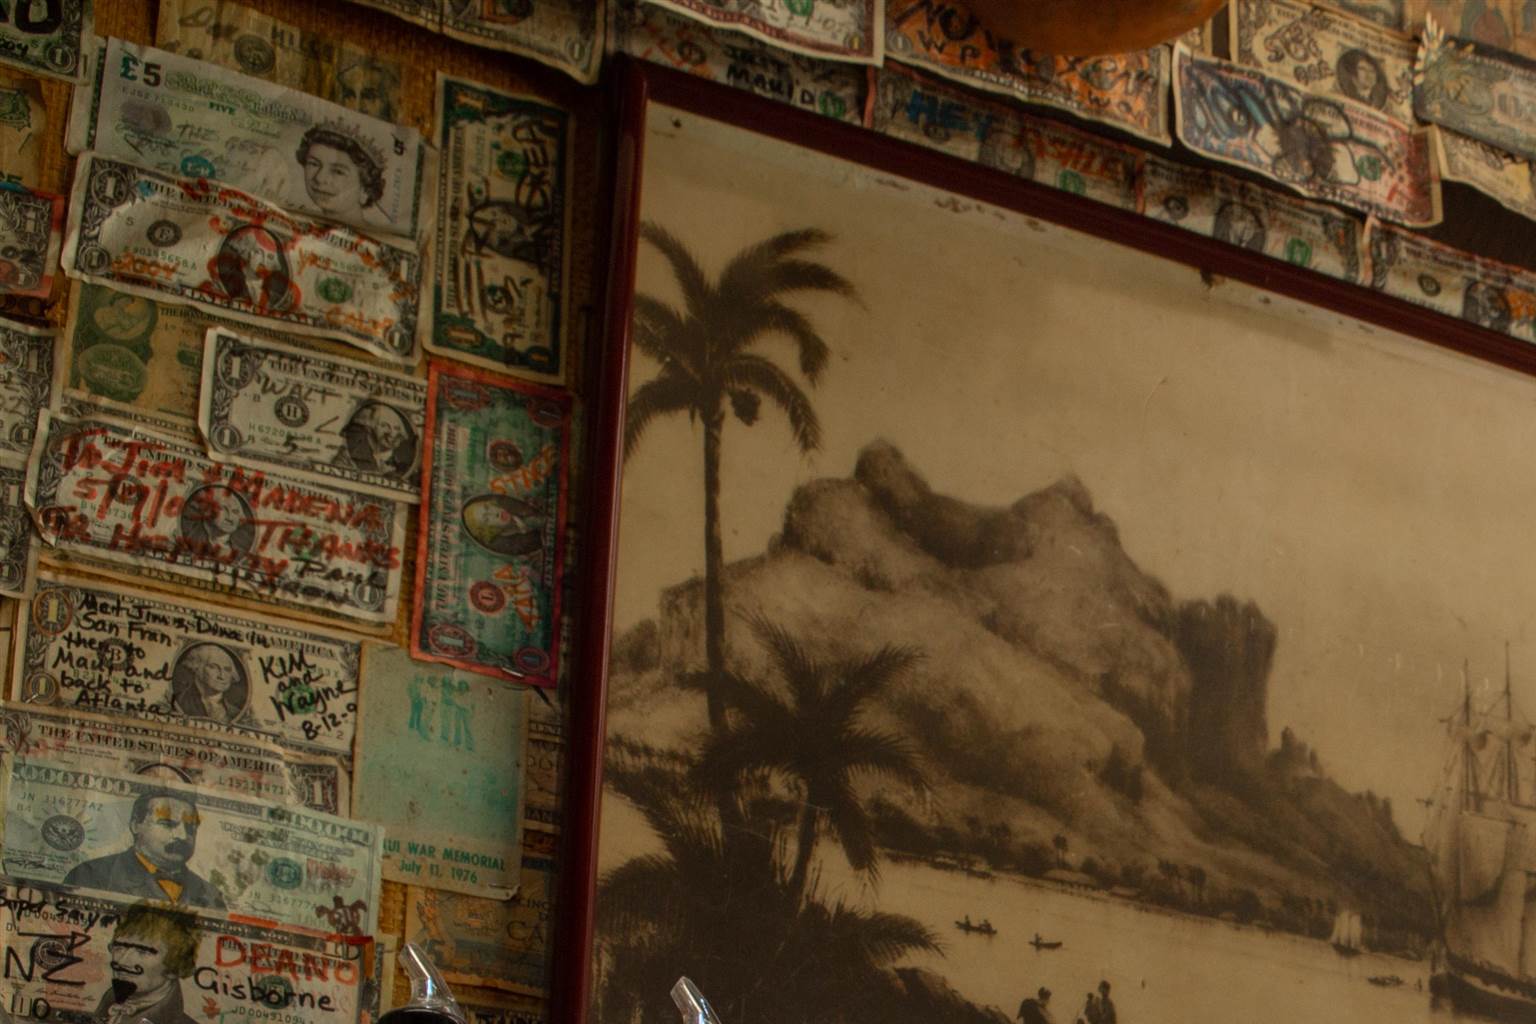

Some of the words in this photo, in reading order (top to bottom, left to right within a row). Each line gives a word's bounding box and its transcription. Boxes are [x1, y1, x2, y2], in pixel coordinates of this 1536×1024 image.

[119, 54, 161, 89] £5
[80, 612, 120, 637] San
[127, 622, 172, 647] Fran
[125, 641, 147, 659] to
[125, 662, 174, 681] and
[259, 651, 316, 684] KIM
[61, 670, 112, 692] back
[120, 678, 145, 694] to
[277, 671, 324, 694] and
[219, 752, 281, 775] AMERIC
[407, 842, 436, 858] WAR
[442, 847, 506, 871] MEMORIAL
[399, 858, 422, 877] July
[451, 867, 479, 884] 1976
[215, 934, 359, 987] DEANO
[194, 966, 336, 1014] Gisborne
